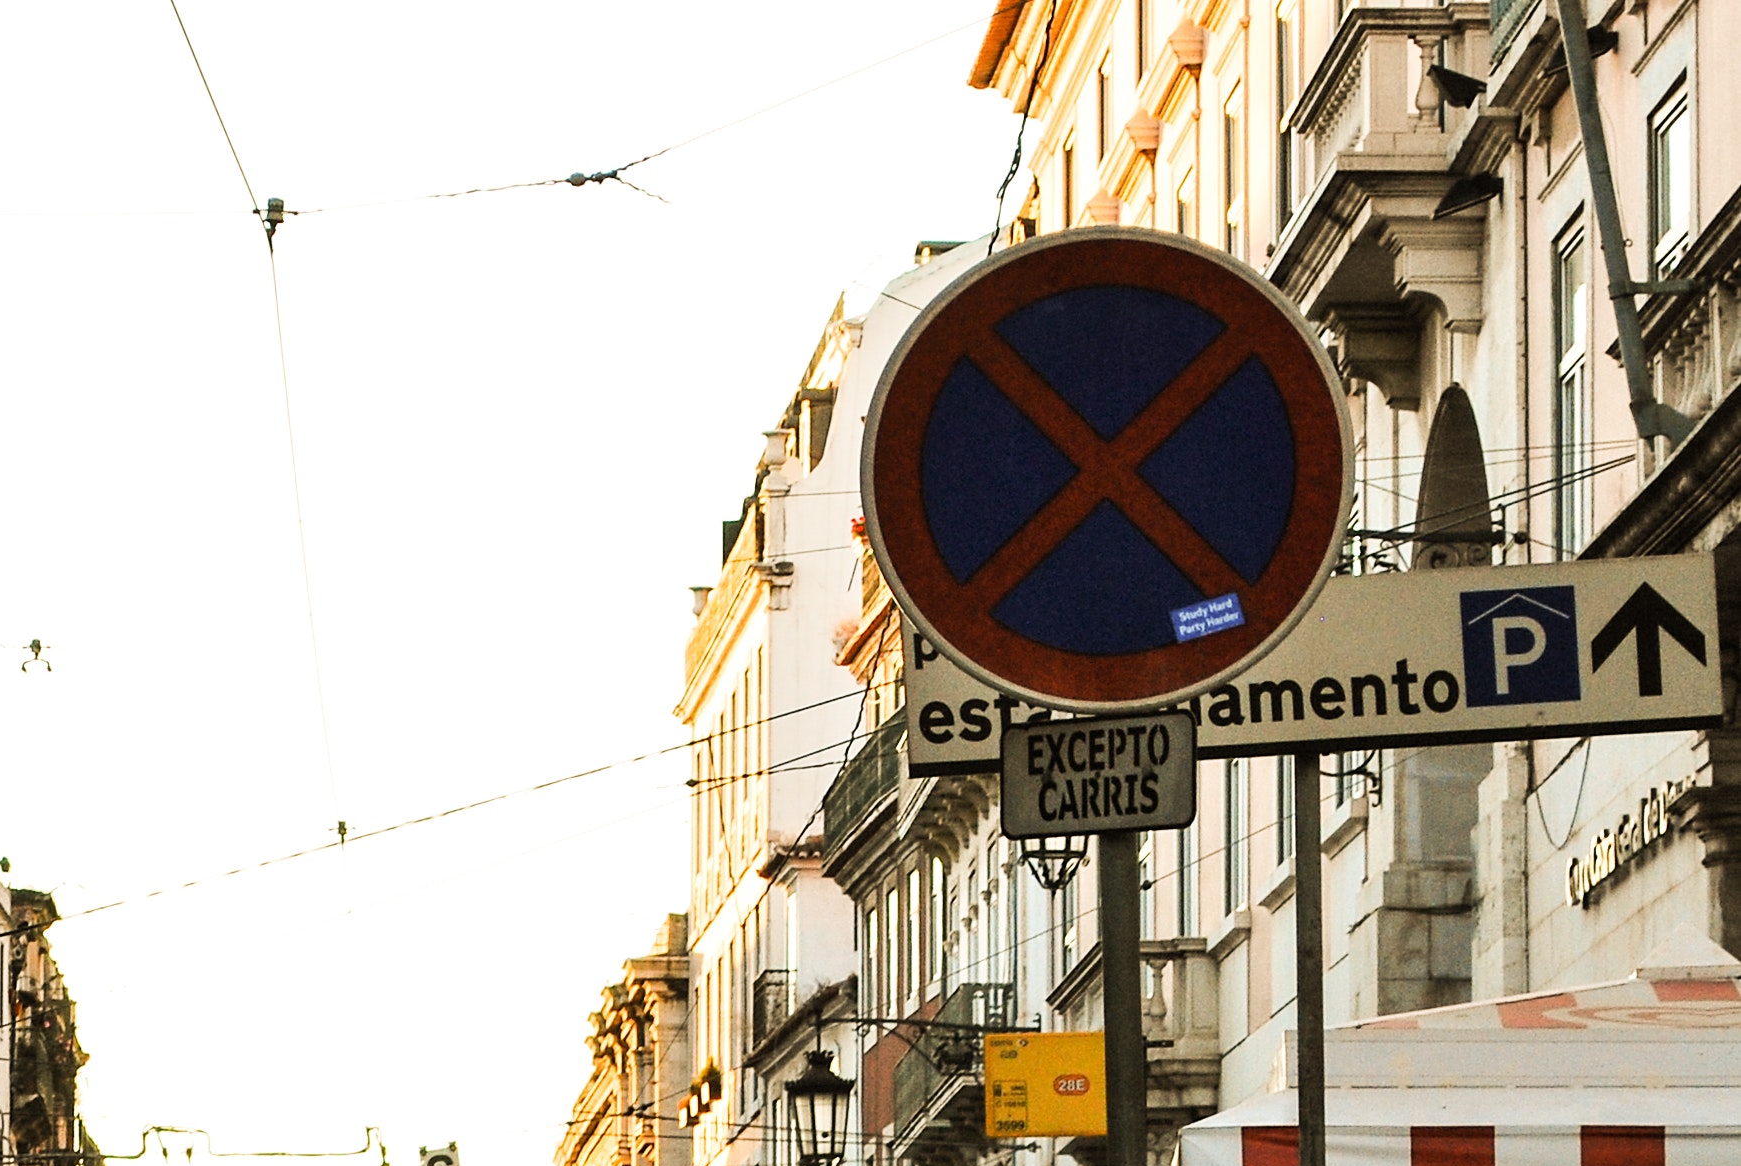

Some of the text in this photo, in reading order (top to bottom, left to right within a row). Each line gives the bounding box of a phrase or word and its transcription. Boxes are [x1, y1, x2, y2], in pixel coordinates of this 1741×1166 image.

[1178, 598, 1233, 622] Study Hard
[1179, 611, 1239, 636] Party Harder
[1027, 723, 1170, 776] EXCEPTO
[1037, 771, 1160, 822] CARRIS
[1057, 1079, 1086, 1092] 28E
